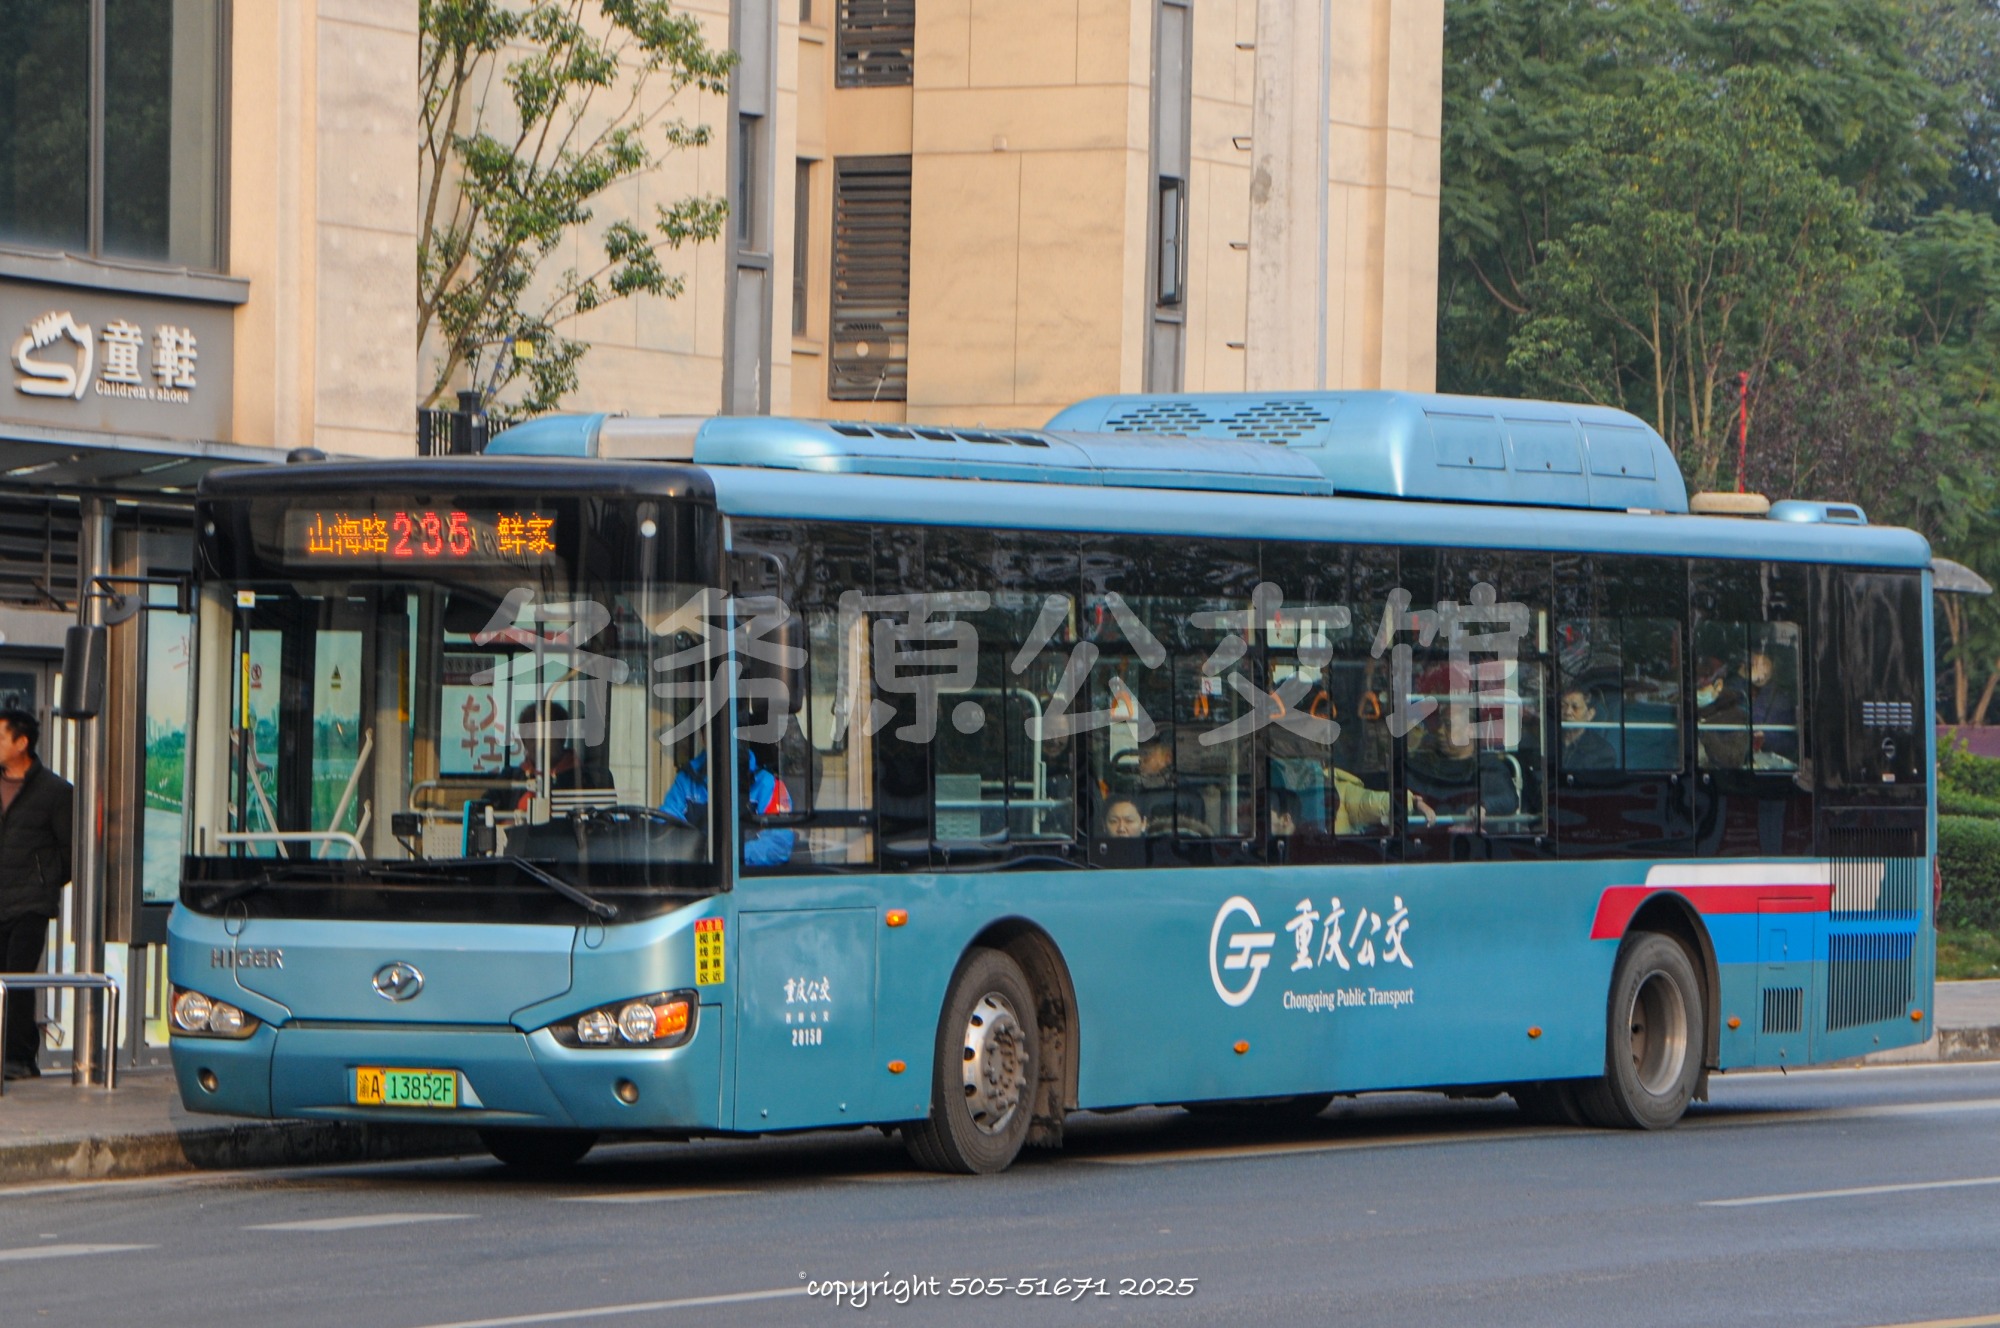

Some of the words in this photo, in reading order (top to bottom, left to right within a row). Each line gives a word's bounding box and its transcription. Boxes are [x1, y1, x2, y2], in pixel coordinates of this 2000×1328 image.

[102, 319, 198, 388] 童鞋
[309, 513, 389, 554] 山海路
[393, 512, 470, 555] 235
[1285, 896, 1414, 972] 重庆公交
[211, 947, 284, 970] HIGER
[784, 975, 832, 1005] 重庆公交
[1283, 990, 1335, 1013] Chongqing
[1336, 988, 1366, 1007] Public
[1368, 987, 1414, 1009] Transport
